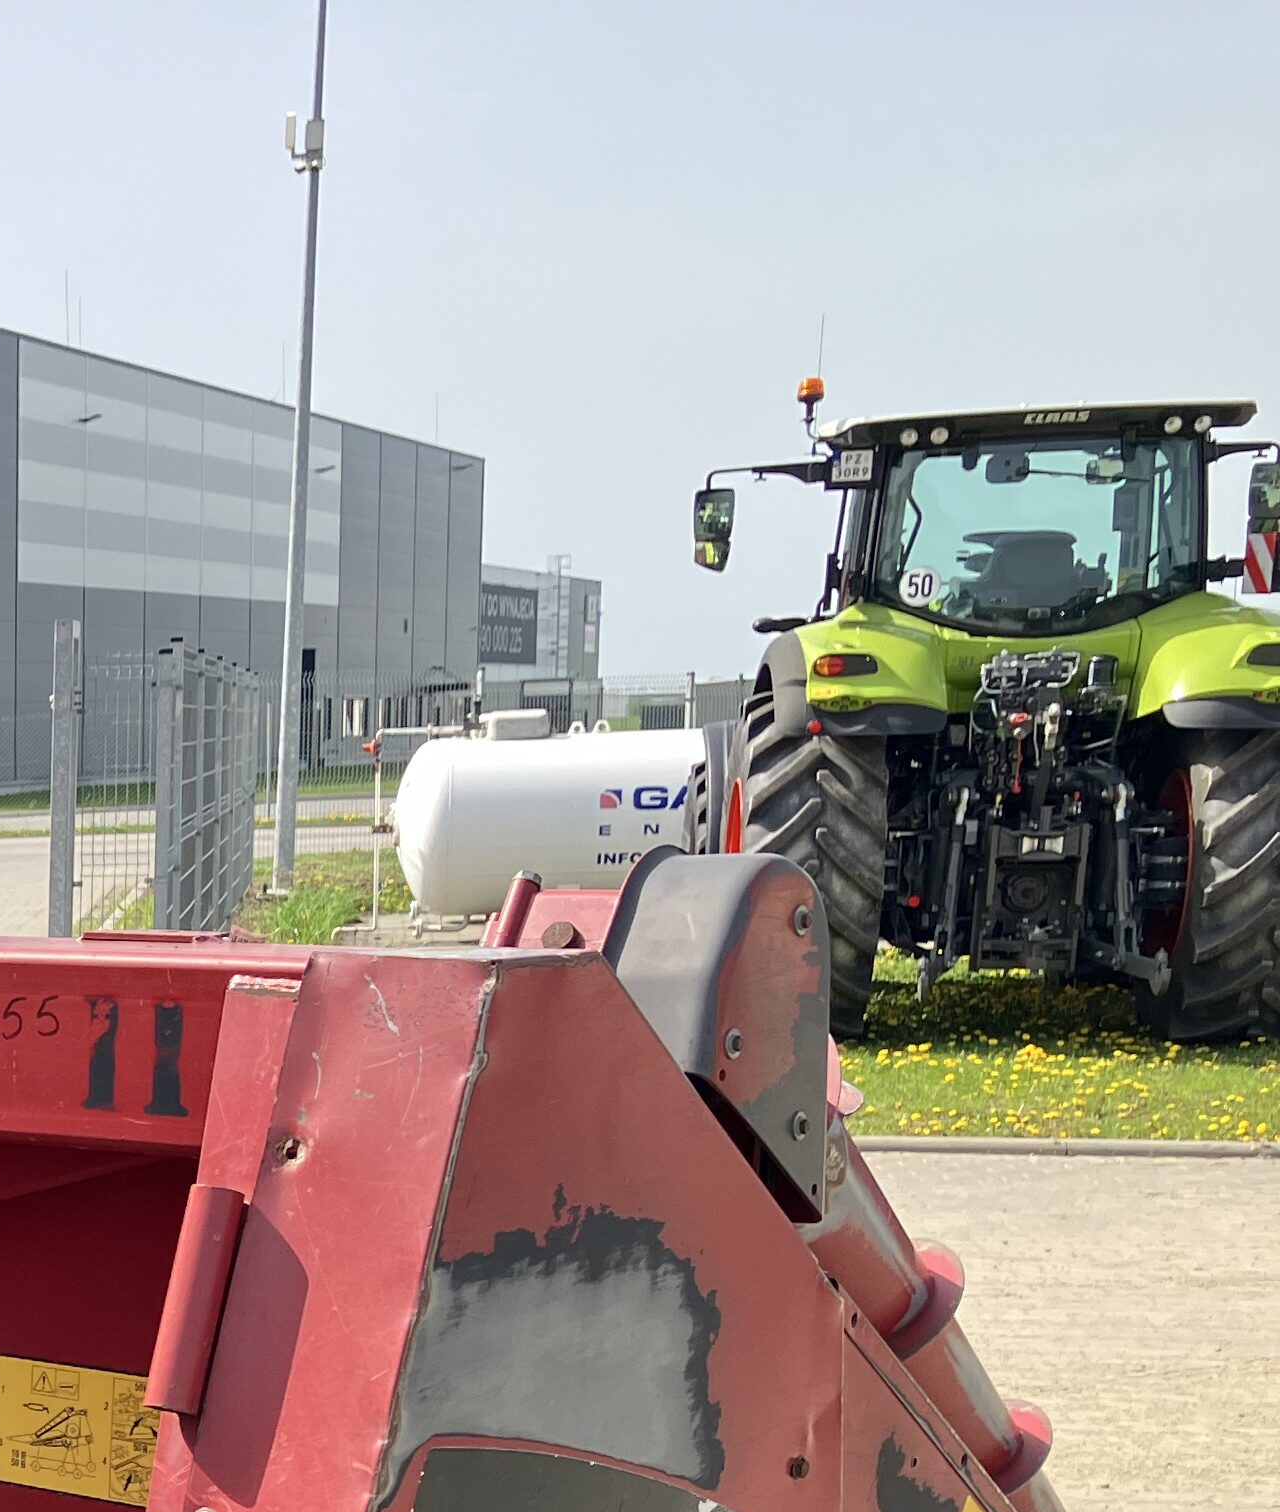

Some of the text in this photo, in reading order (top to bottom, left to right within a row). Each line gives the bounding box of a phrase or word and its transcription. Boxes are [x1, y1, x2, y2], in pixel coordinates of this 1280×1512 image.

[1024, 411, 1090, 425] CLAAS
[845, 453, 862, 465] PZ
[908, 573, 933, 598] 50
[488, 594, 498, 617] DO
[493, 625, 508, 652] 000
[509, 627, 522, 653] 225
